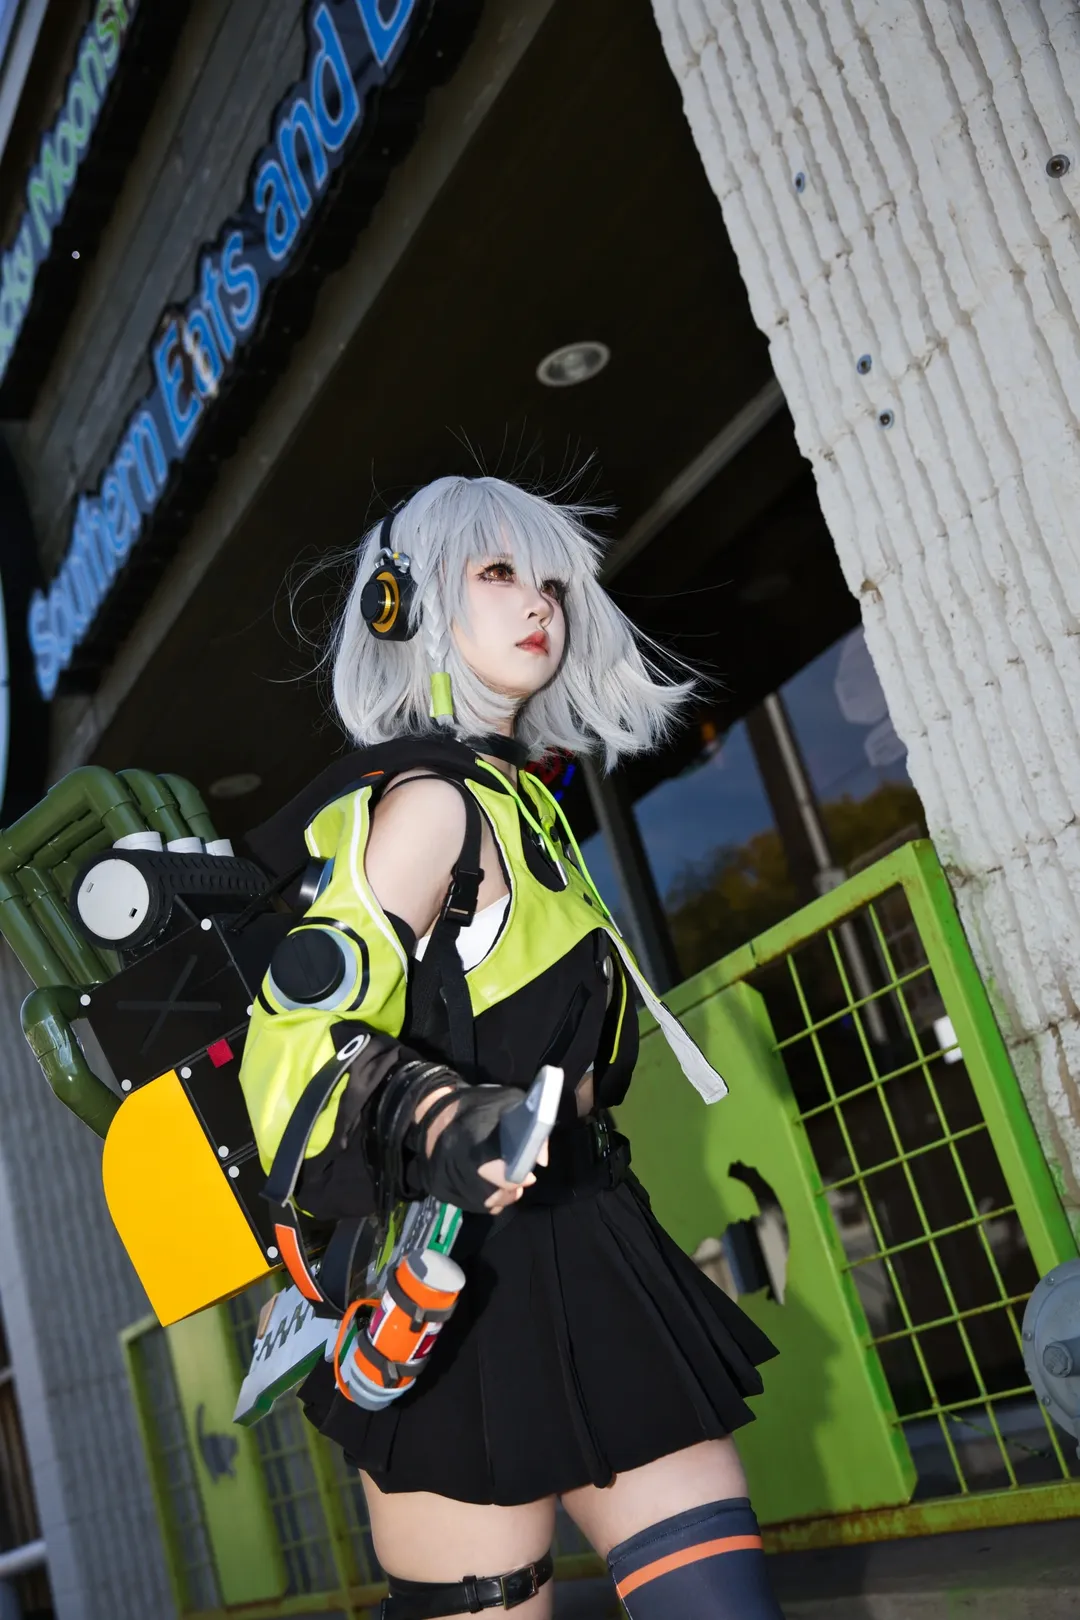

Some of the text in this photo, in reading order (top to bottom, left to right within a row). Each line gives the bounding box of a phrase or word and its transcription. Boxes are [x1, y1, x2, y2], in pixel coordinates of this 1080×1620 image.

[29, 2, 360, 695] Southern Eats and
